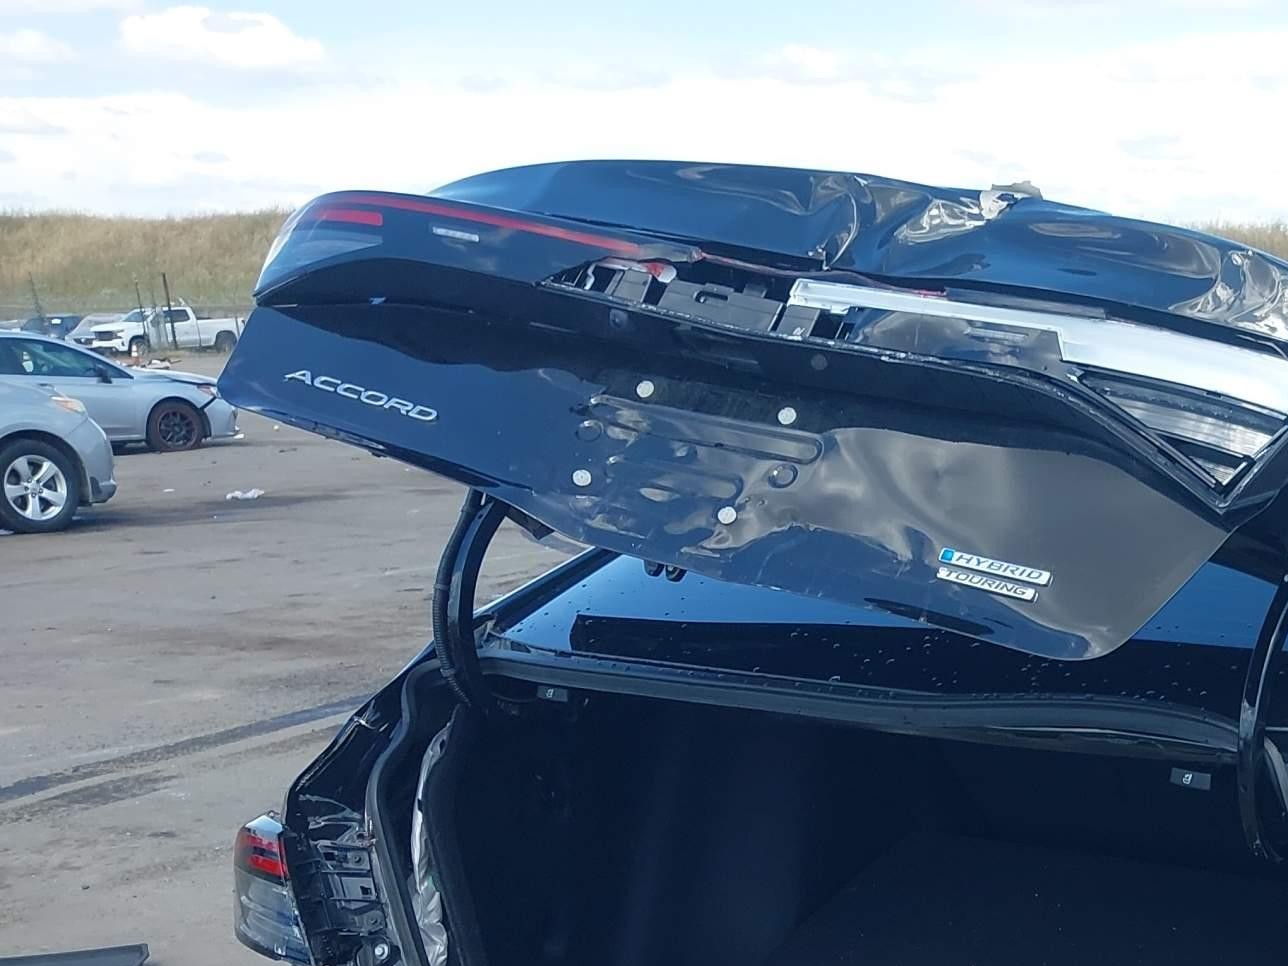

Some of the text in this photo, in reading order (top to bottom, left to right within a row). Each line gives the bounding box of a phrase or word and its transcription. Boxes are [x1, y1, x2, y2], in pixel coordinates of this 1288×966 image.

[283, 369, 439, 421] ACCORD
[955, 553, 1044, 581] HYBRID
[944, 569, 1028, 597] TOURING
